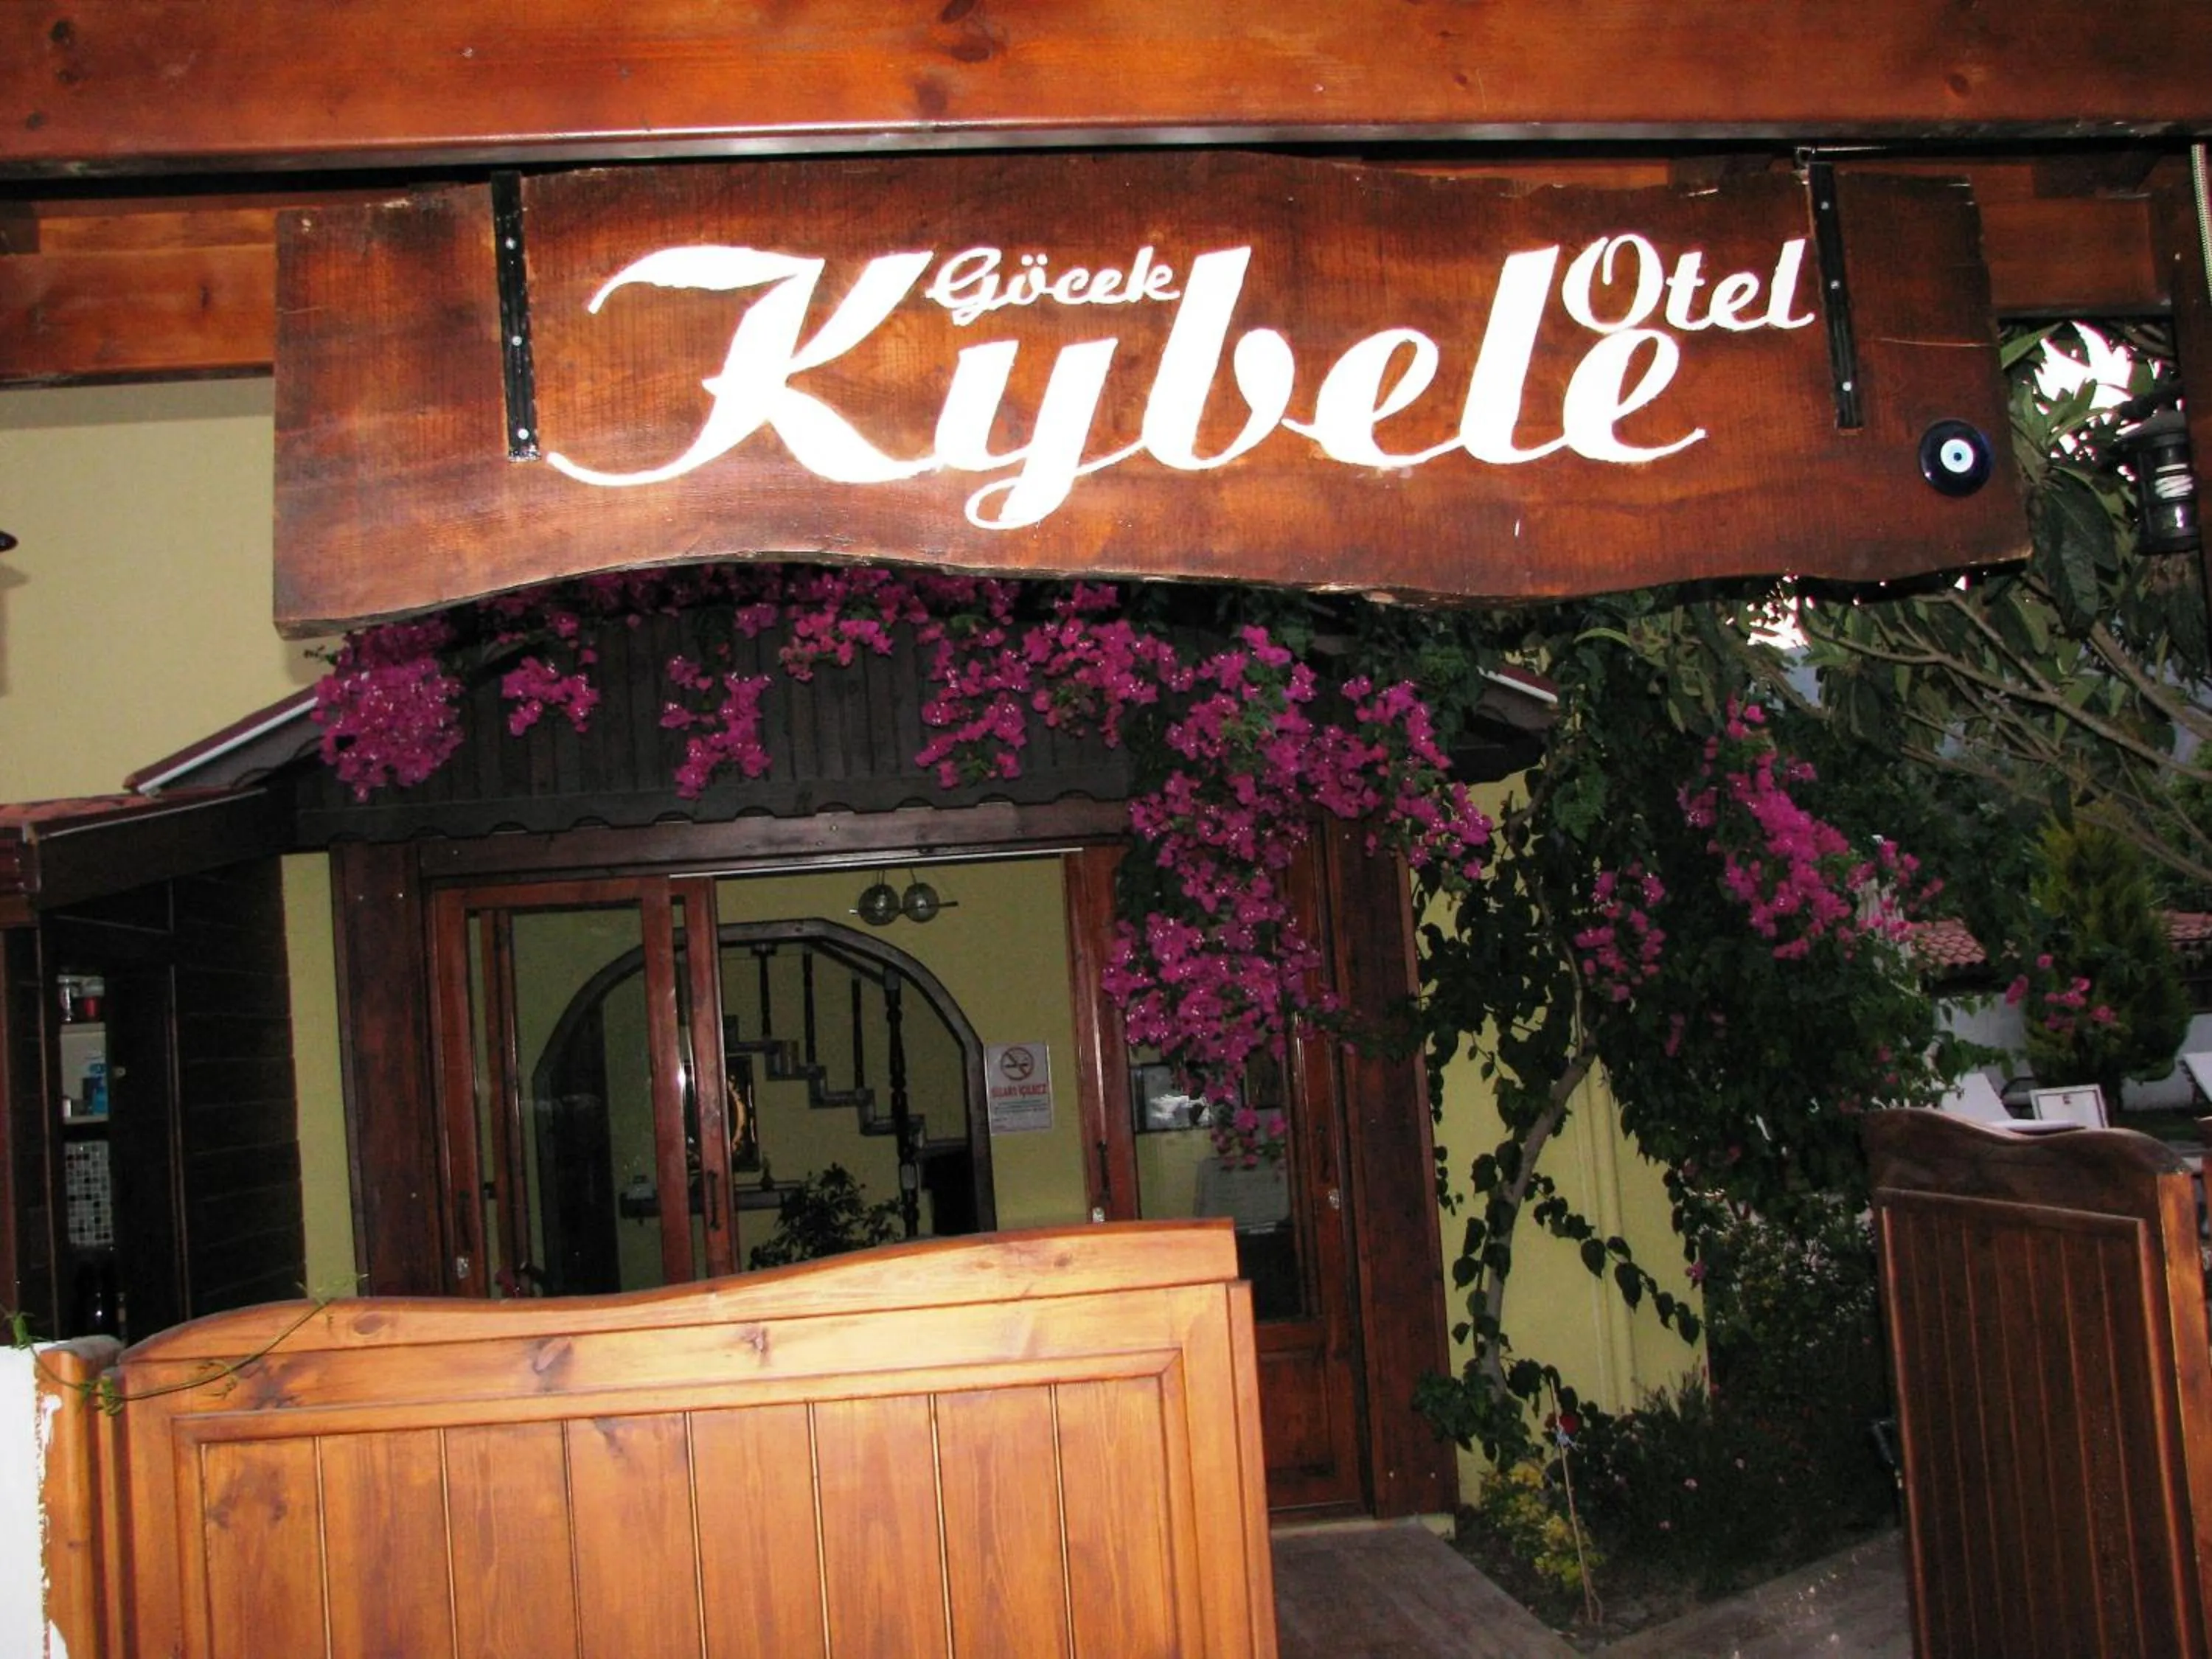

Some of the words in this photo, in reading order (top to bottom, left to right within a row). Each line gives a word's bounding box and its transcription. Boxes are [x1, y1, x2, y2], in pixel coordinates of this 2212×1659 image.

[924, 246, 1181, 327] Göcek
[1561, 232, 1816, 335] Otel
[544, 244, 1707, 532] Kybele
